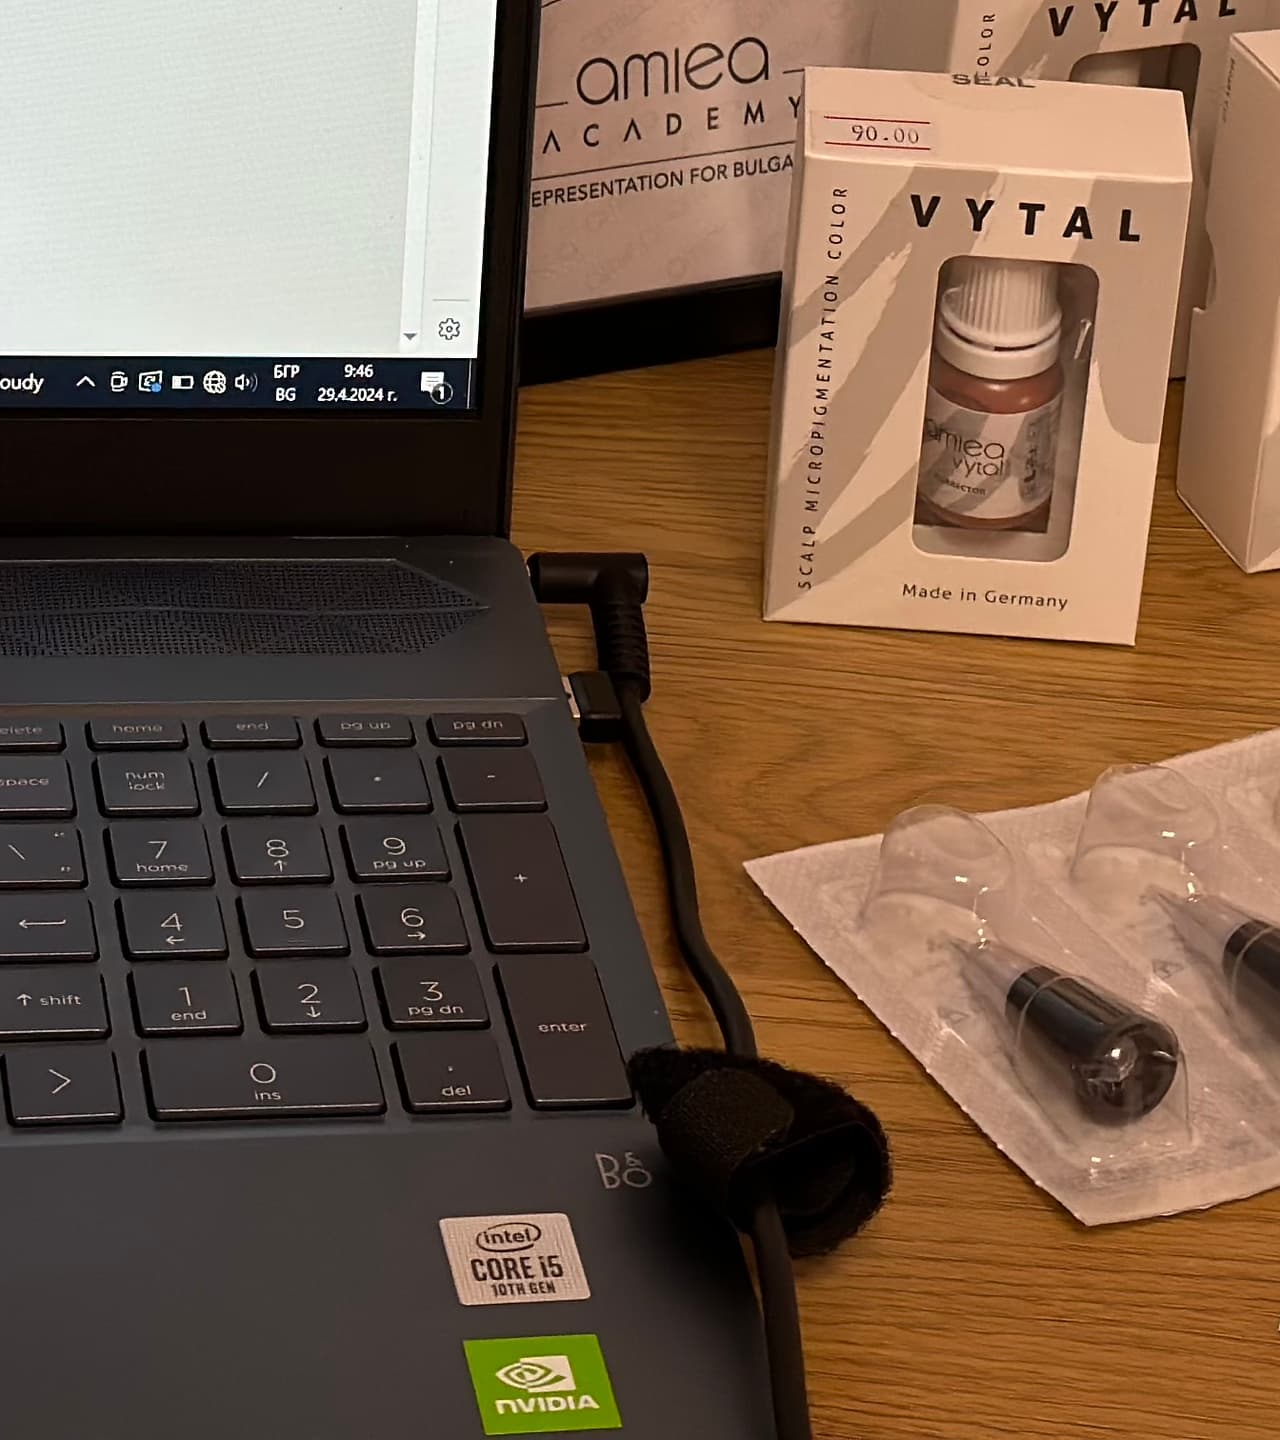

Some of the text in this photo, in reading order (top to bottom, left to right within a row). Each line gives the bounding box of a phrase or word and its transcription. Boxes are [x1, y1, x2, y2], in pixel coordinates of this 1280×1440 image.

[576, 36, 770, 105] amiea
[851, 123, 920, 145] 90.00
[690, 164, 727, 185] FOR
[733, 154, 794, 178] BULGA
[910, 194, 1141, 243] VYTAL
[274, 364, 300, 379] БГР
[344, 364, 374, 378] 9:46
[276, 388, 296, 401] BG
[798, 186, 848, 590] SCALP MICROPIGMENTATION COLOR
[902, 583, 1069, 611] Made in Germany
[113, 723, 164, 734] home
[236, 720, 269, 731] end
[341, 720, 392, 732] pg up
[453, 719, 504, 731] pg dn
[125, 771, 165, 781] num
[148, 840, 168, 859] 7
[266, 838, 290, 858] 8
[382, 837, 407, 856] 9
[136, 862, 189, 873] home
[373, 859, 426, 871] pg up
[160, 912, 183, 932] 4
[283, 910, 304, 929] 5
[401, 908, 424, 928] 6
[177, 986, 191, 1007] 1
[297, 984, 321, 1005] 2
[420, 981, 444, 1001] 3
[39, 994, 82, 1007] shift
[171, 1010, 207, 1021] end
[408, 1002, 463, 1017] pg dn
[538, 1021, 587, 1033] enter
[254, 1089, 281, 1101] ins
[441, 1084, 472, 1097] del
[483, 1227, 532, 1244] intel
[470, 1255, 564, 1282] CORE i5
[491, 1281, 556, 1297] 10TH GEN
[495, 1395, 600, 1415] NVIDIA
